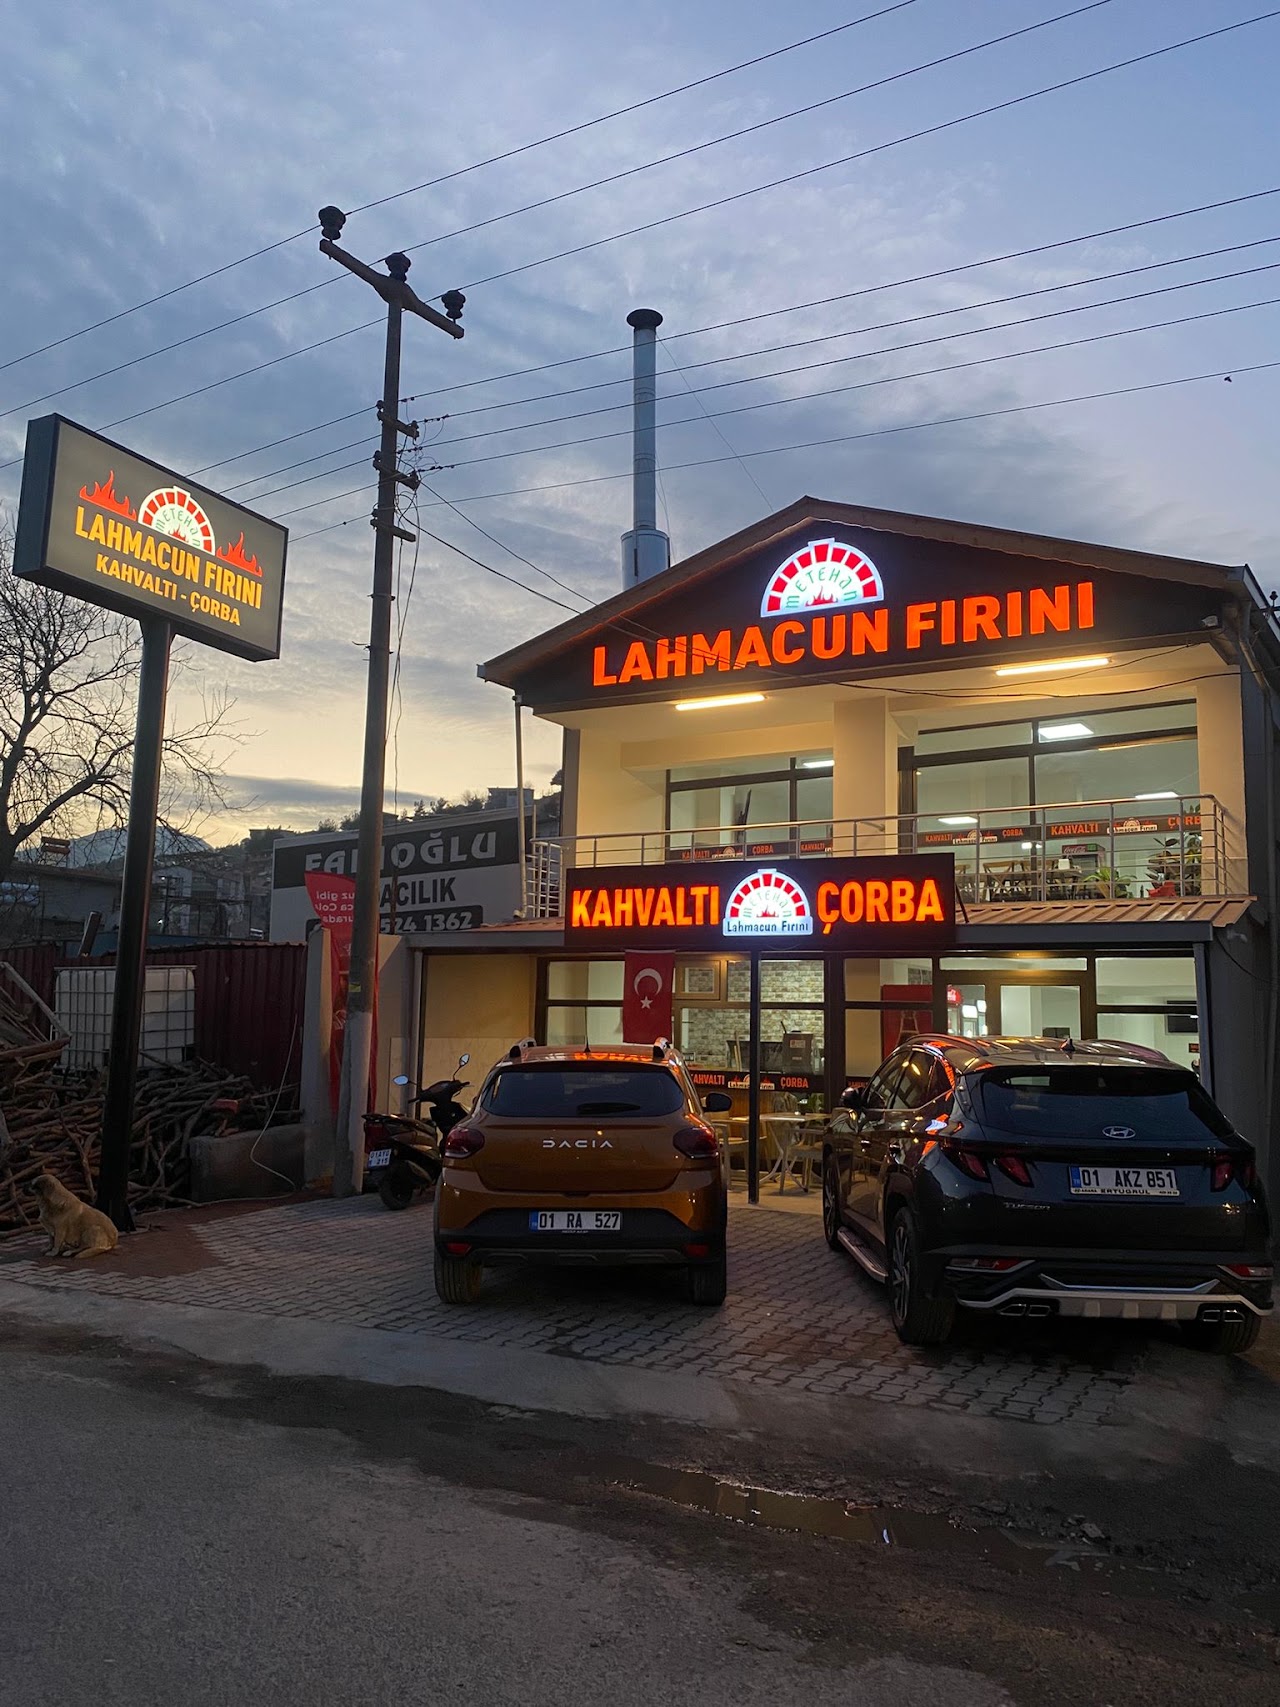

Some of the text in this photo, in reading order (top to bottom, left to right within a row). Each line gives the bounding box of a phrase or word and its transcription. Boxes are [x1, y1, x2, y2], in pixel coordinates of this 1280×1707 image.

[75, 505, 262, 609] LAHMACUN FIRINI
[96, 553, 177, 601] KAHVALTI
[189, 591, 241, 626] ÇORBA
[592, 581, 1095, 687] LAHMACUN FIRINI
[1051, 824, 1099, 836] KAHVALTI
[305, 831, 496, 874] FAOĞLU
[681, 850, 710, 860] KAVALTI
[752, 845, 774, 855] ÇORBA
[380, 876, 456, 908] ACILIK
[571, 885, 720, 928] KAHVALTI
[817, 879, 945, 935] ÇORBA
[424, 911, 473, 931] 1362
[727, 920, 777, 933] Lahmacun
[691, 1073, 725, 1086] AHVALTI
[780, 1076, 809, 1089] ÇORBA
[542, 1139, 613, 1148] DACIA
[1082, 1169, 1175, 1188] 01 AKZ 851
[539, 1213, 620, 1229] 01 RA 527
